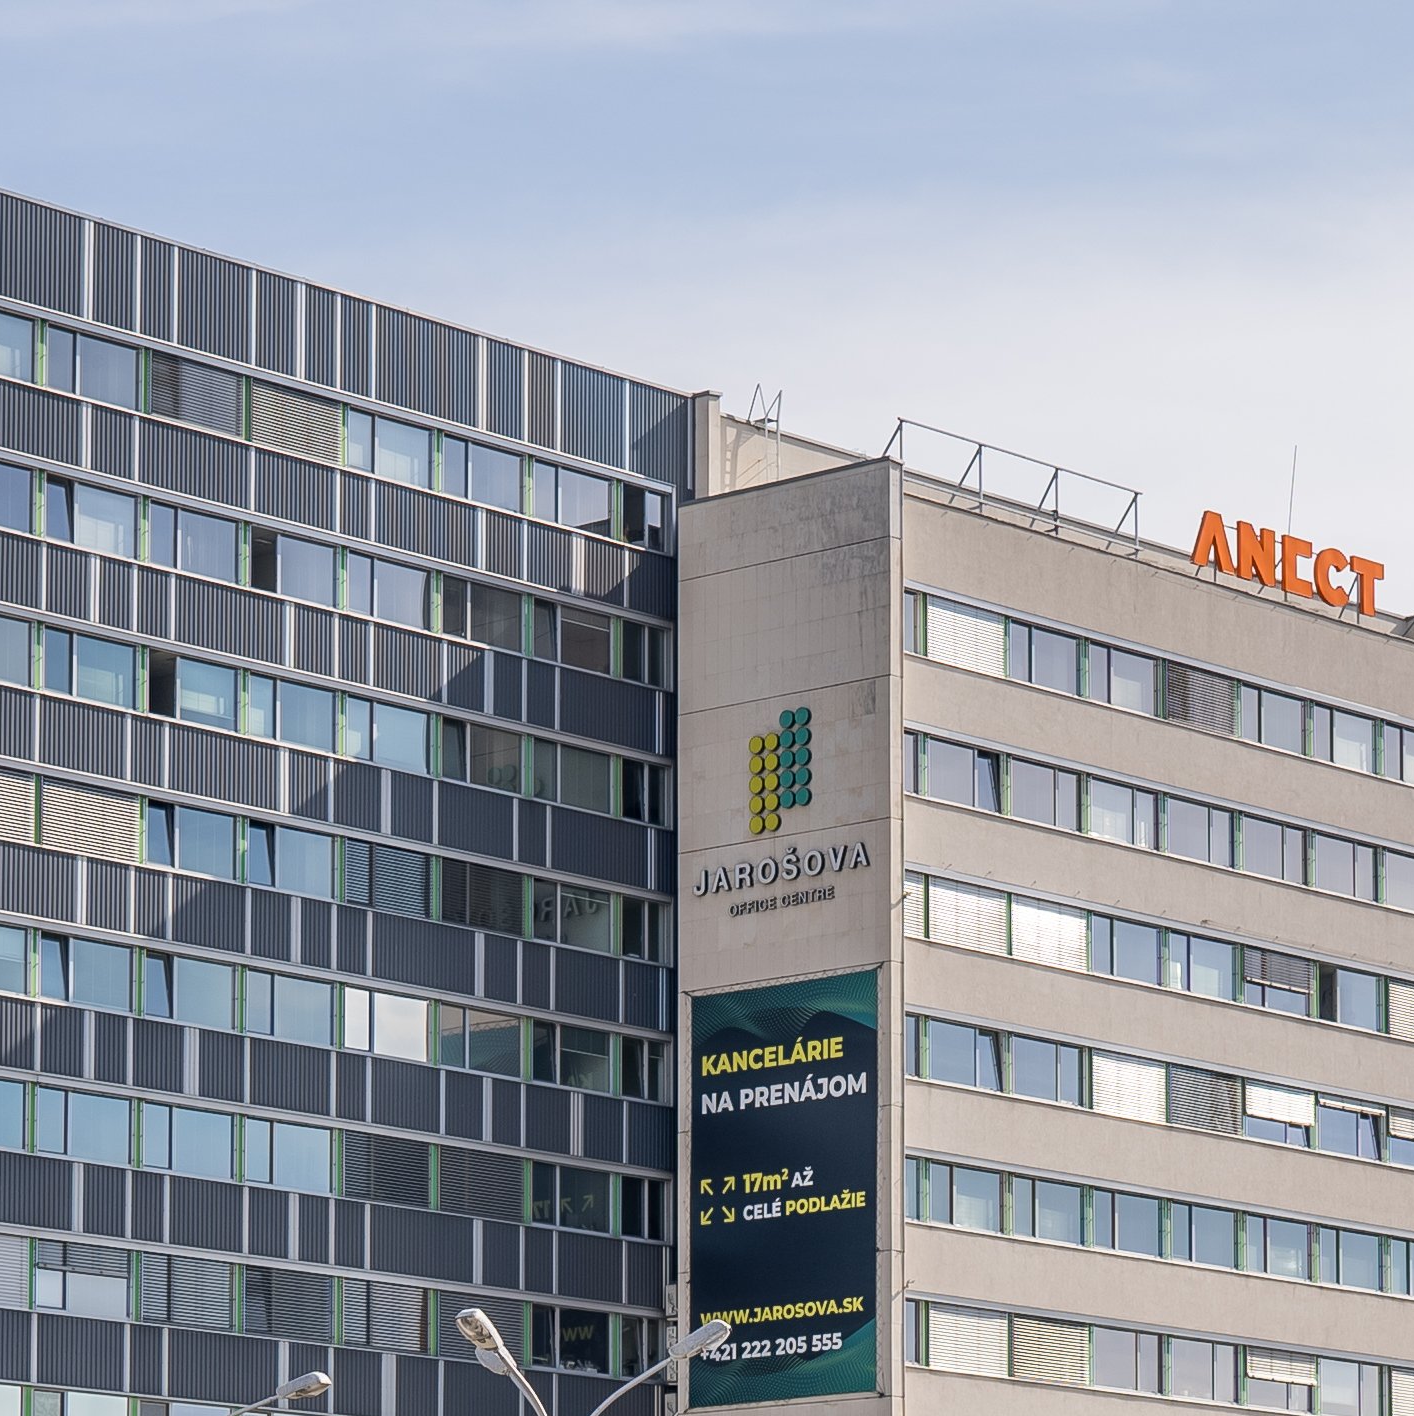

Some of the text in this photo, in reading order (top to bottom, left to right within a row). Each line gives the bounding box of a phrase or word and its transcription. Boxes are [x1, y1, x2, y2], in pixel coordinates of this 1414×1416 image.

[692, 842, 870, 897] JAROŠOVA
[728, 885, 836, 917] OFFICE CENTRE
[701, 1036, 844, 1077] KANCELÁRIE
[701, 1072, 867, 1115] NA PRENÁJOM
[791, 1166, 814, 1188] AŽ
[742, 1188, 866, 1221] CELÉ PODLAŽIE
[700, 1332, 843, 1362] +421 222 205 555
